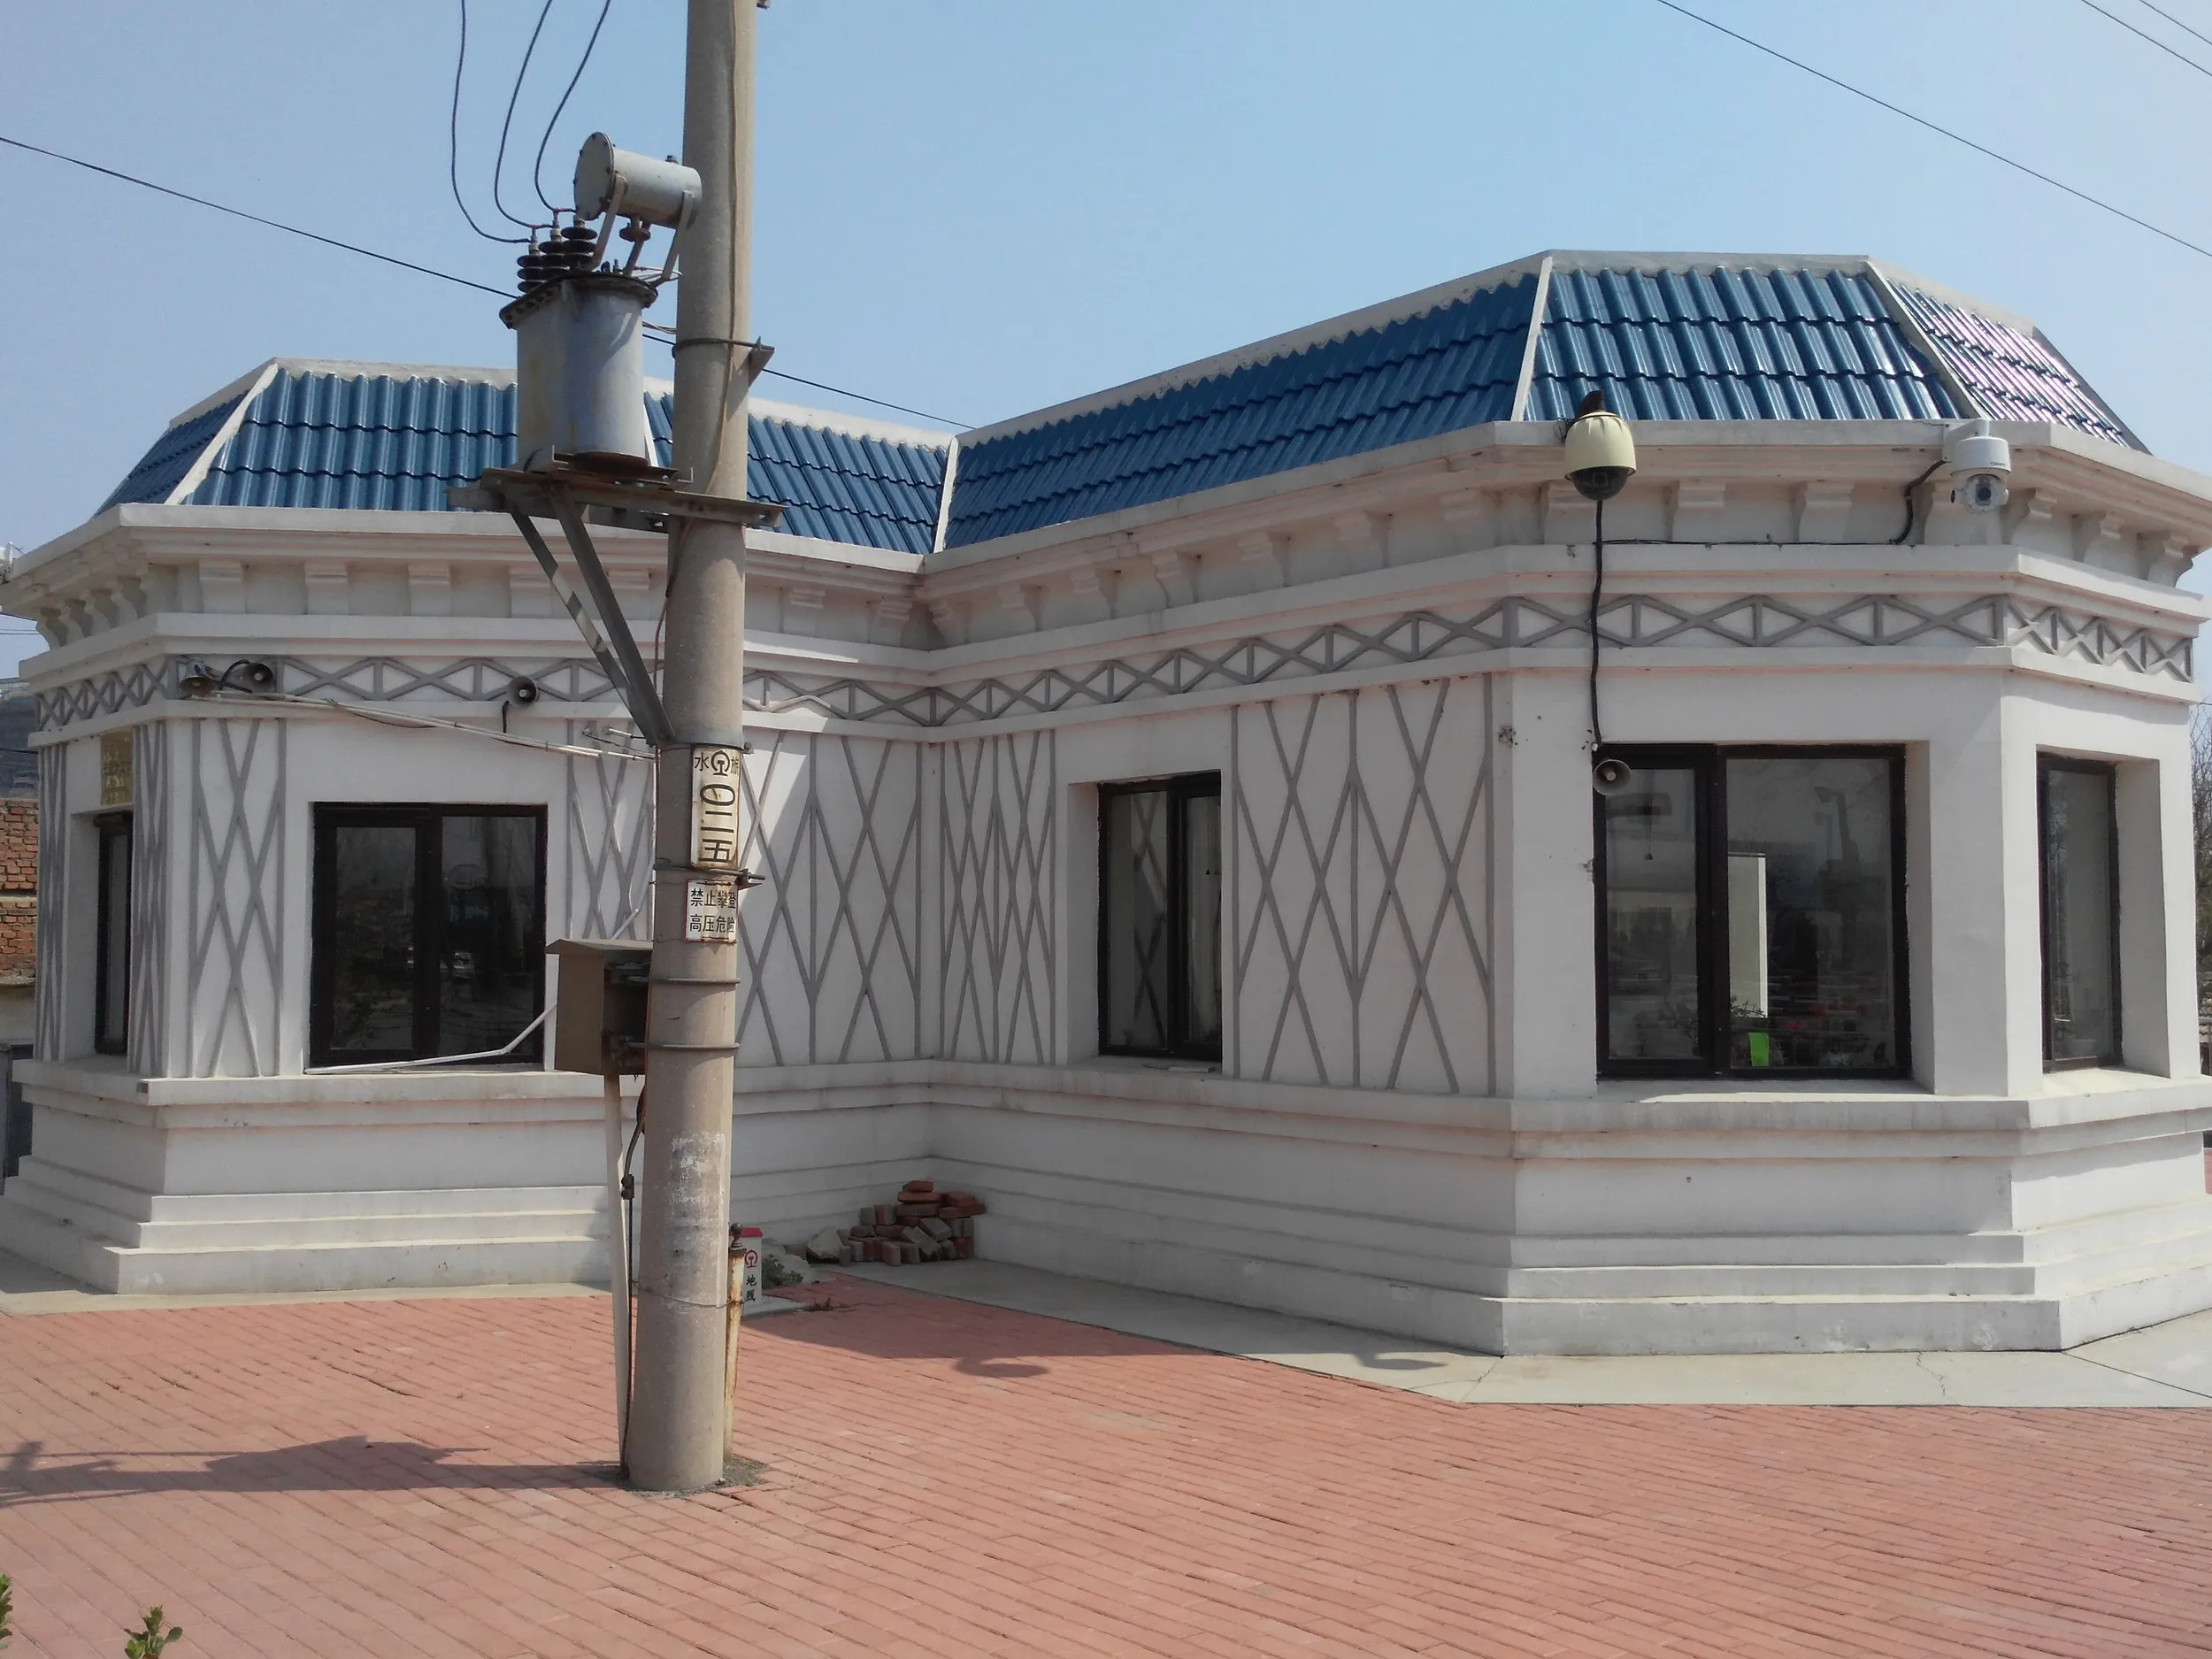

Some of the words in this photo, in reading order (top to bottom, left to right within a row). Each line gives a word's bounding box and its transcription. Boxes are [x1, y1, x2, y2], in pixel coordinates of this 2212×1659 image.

[694, 752, 710, 772] 水
[690, 887, 737, 910] 禁止攀登
[689, 913, 735, 933] 高压危险
[745, 1274, 757, 1302] 地线
